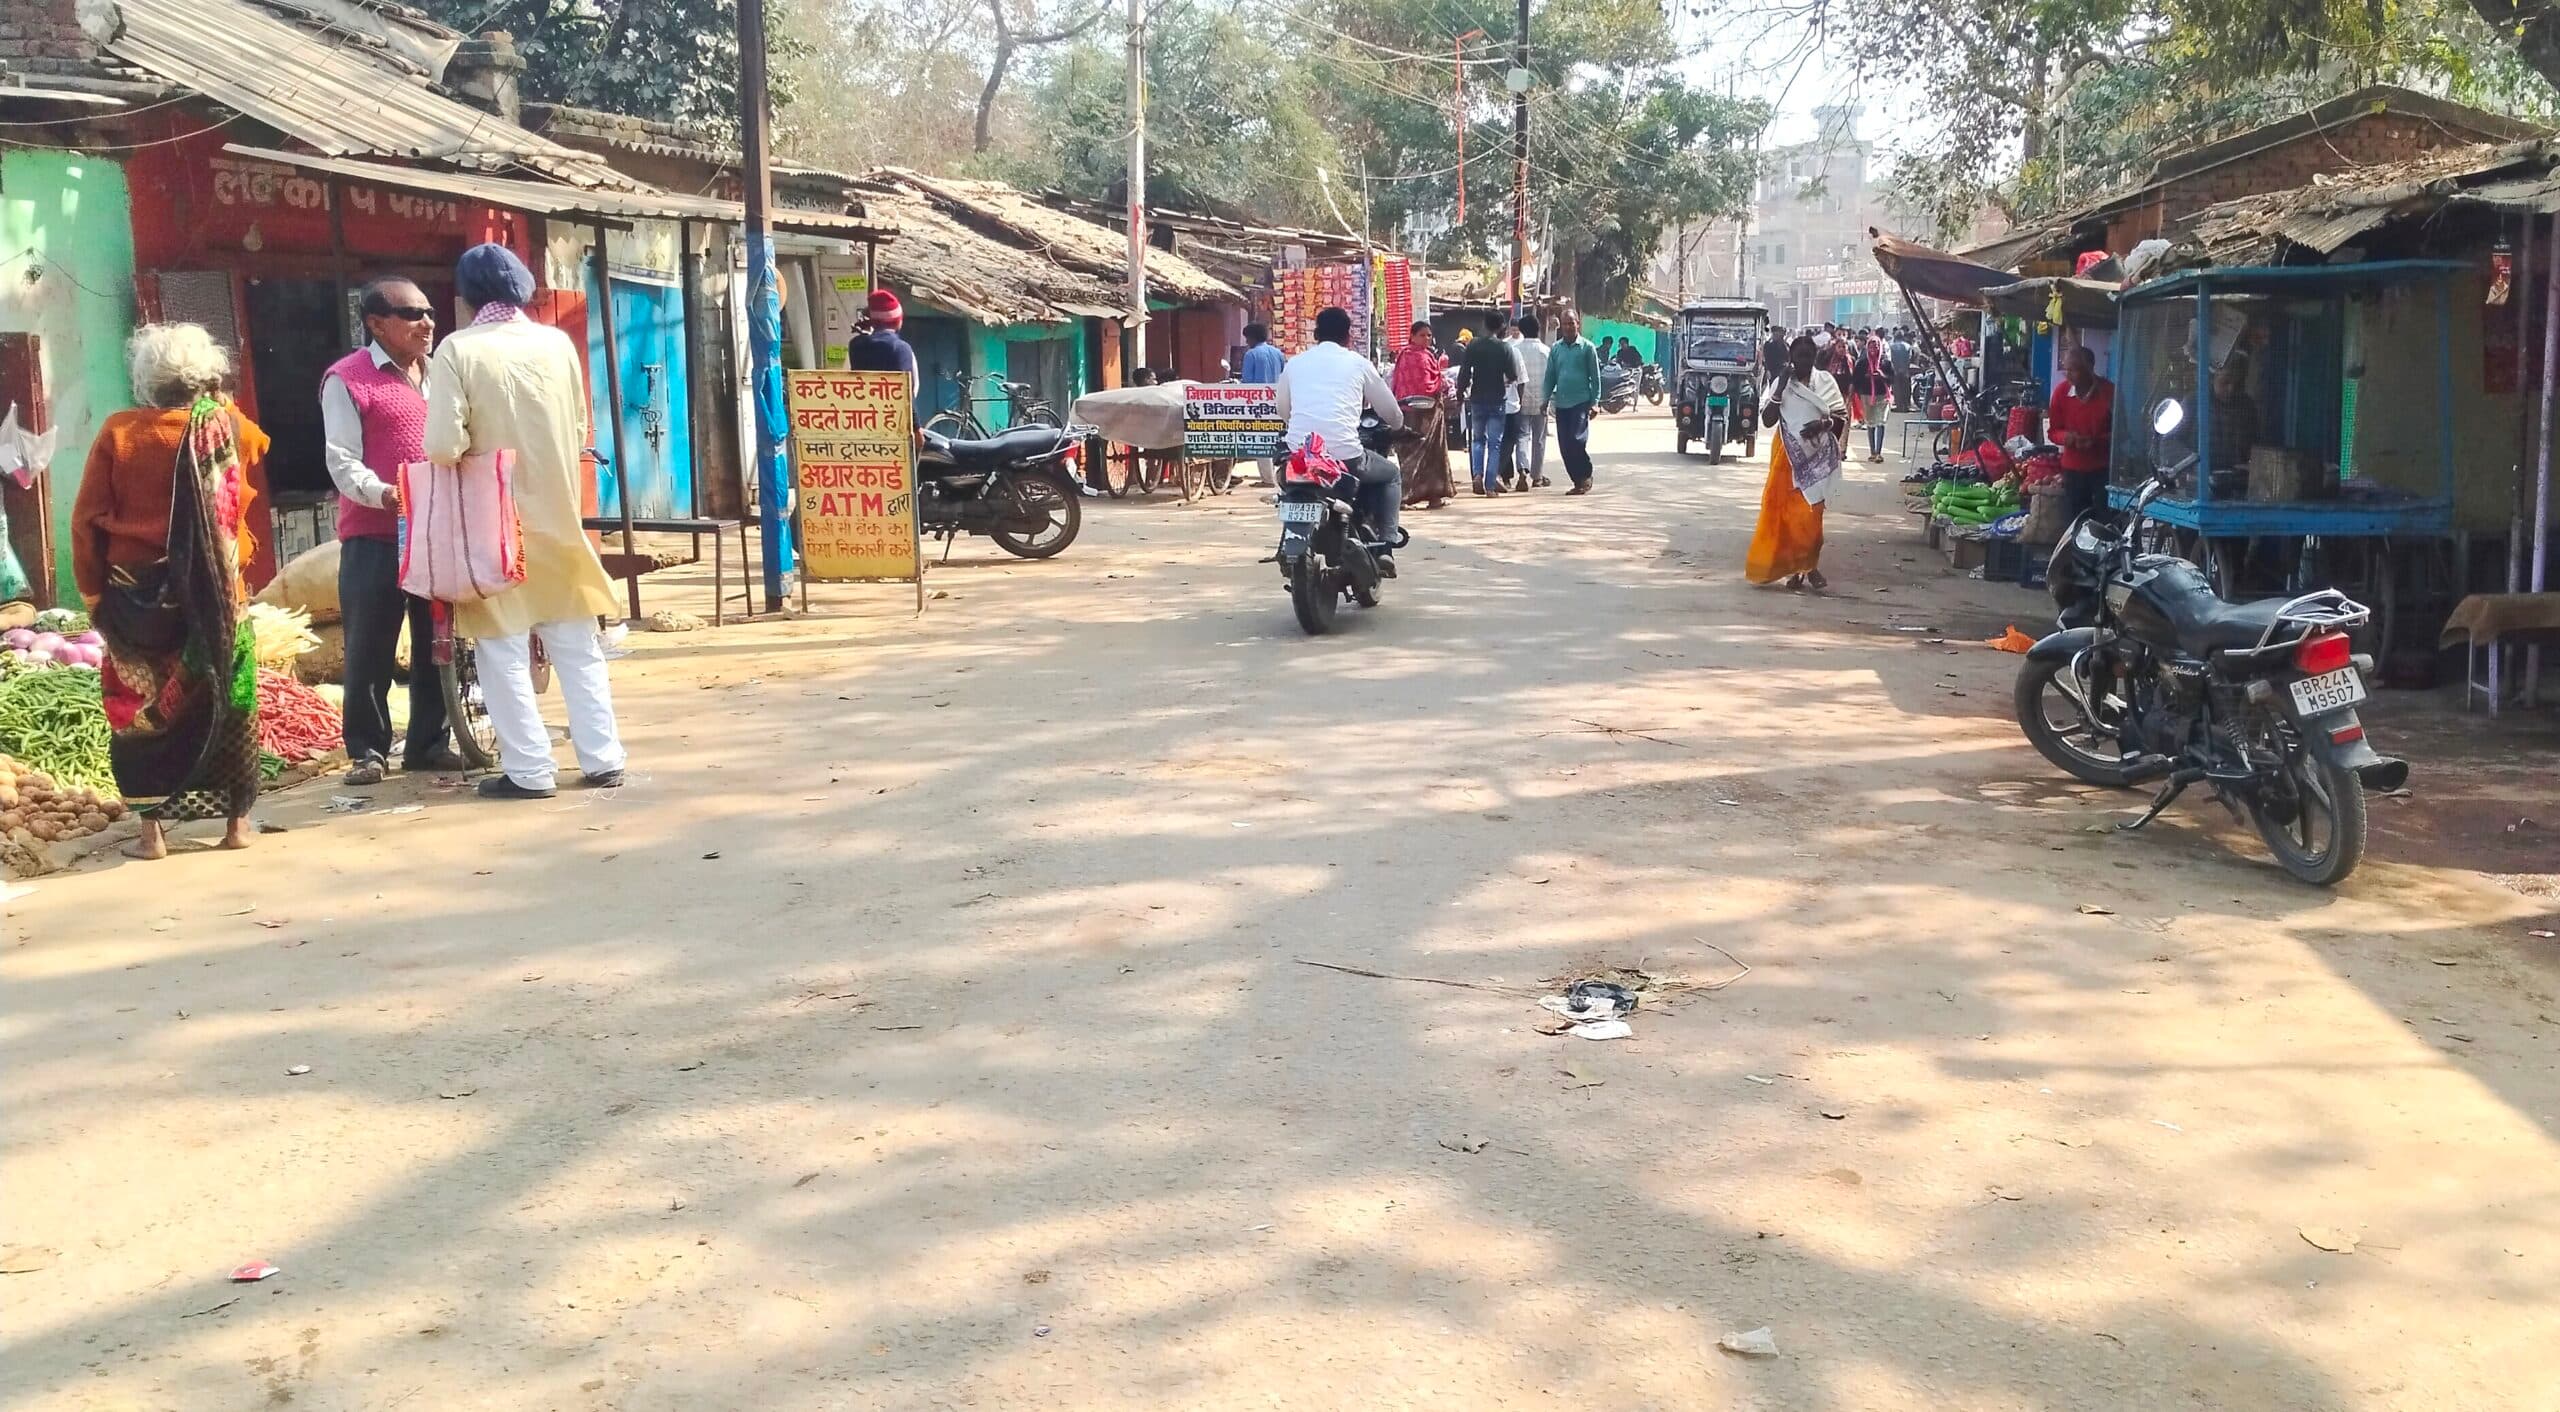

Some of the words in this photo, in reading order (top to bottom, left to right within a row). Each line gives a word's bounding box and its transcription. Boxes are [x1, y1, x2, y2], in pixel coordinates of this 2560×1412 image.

[795, 376, 826, 399] कटे
[831, 376, 865, 400] फटे
[869, 377, 903, 401] नोट
[797, 403, 839, 431] बदले
[842, 403, 878, 431] जाते
[1203, 403, 1245, 416] डिजिटल
[1213, 433, 1234, 443] कार्ड
[800, 463, 854, 489] अधार
[856, 460, 903, 490] कार्ड
[2301, 670, 2351, 695] BR24A
[2307, 685, 2354, 711] M9507
